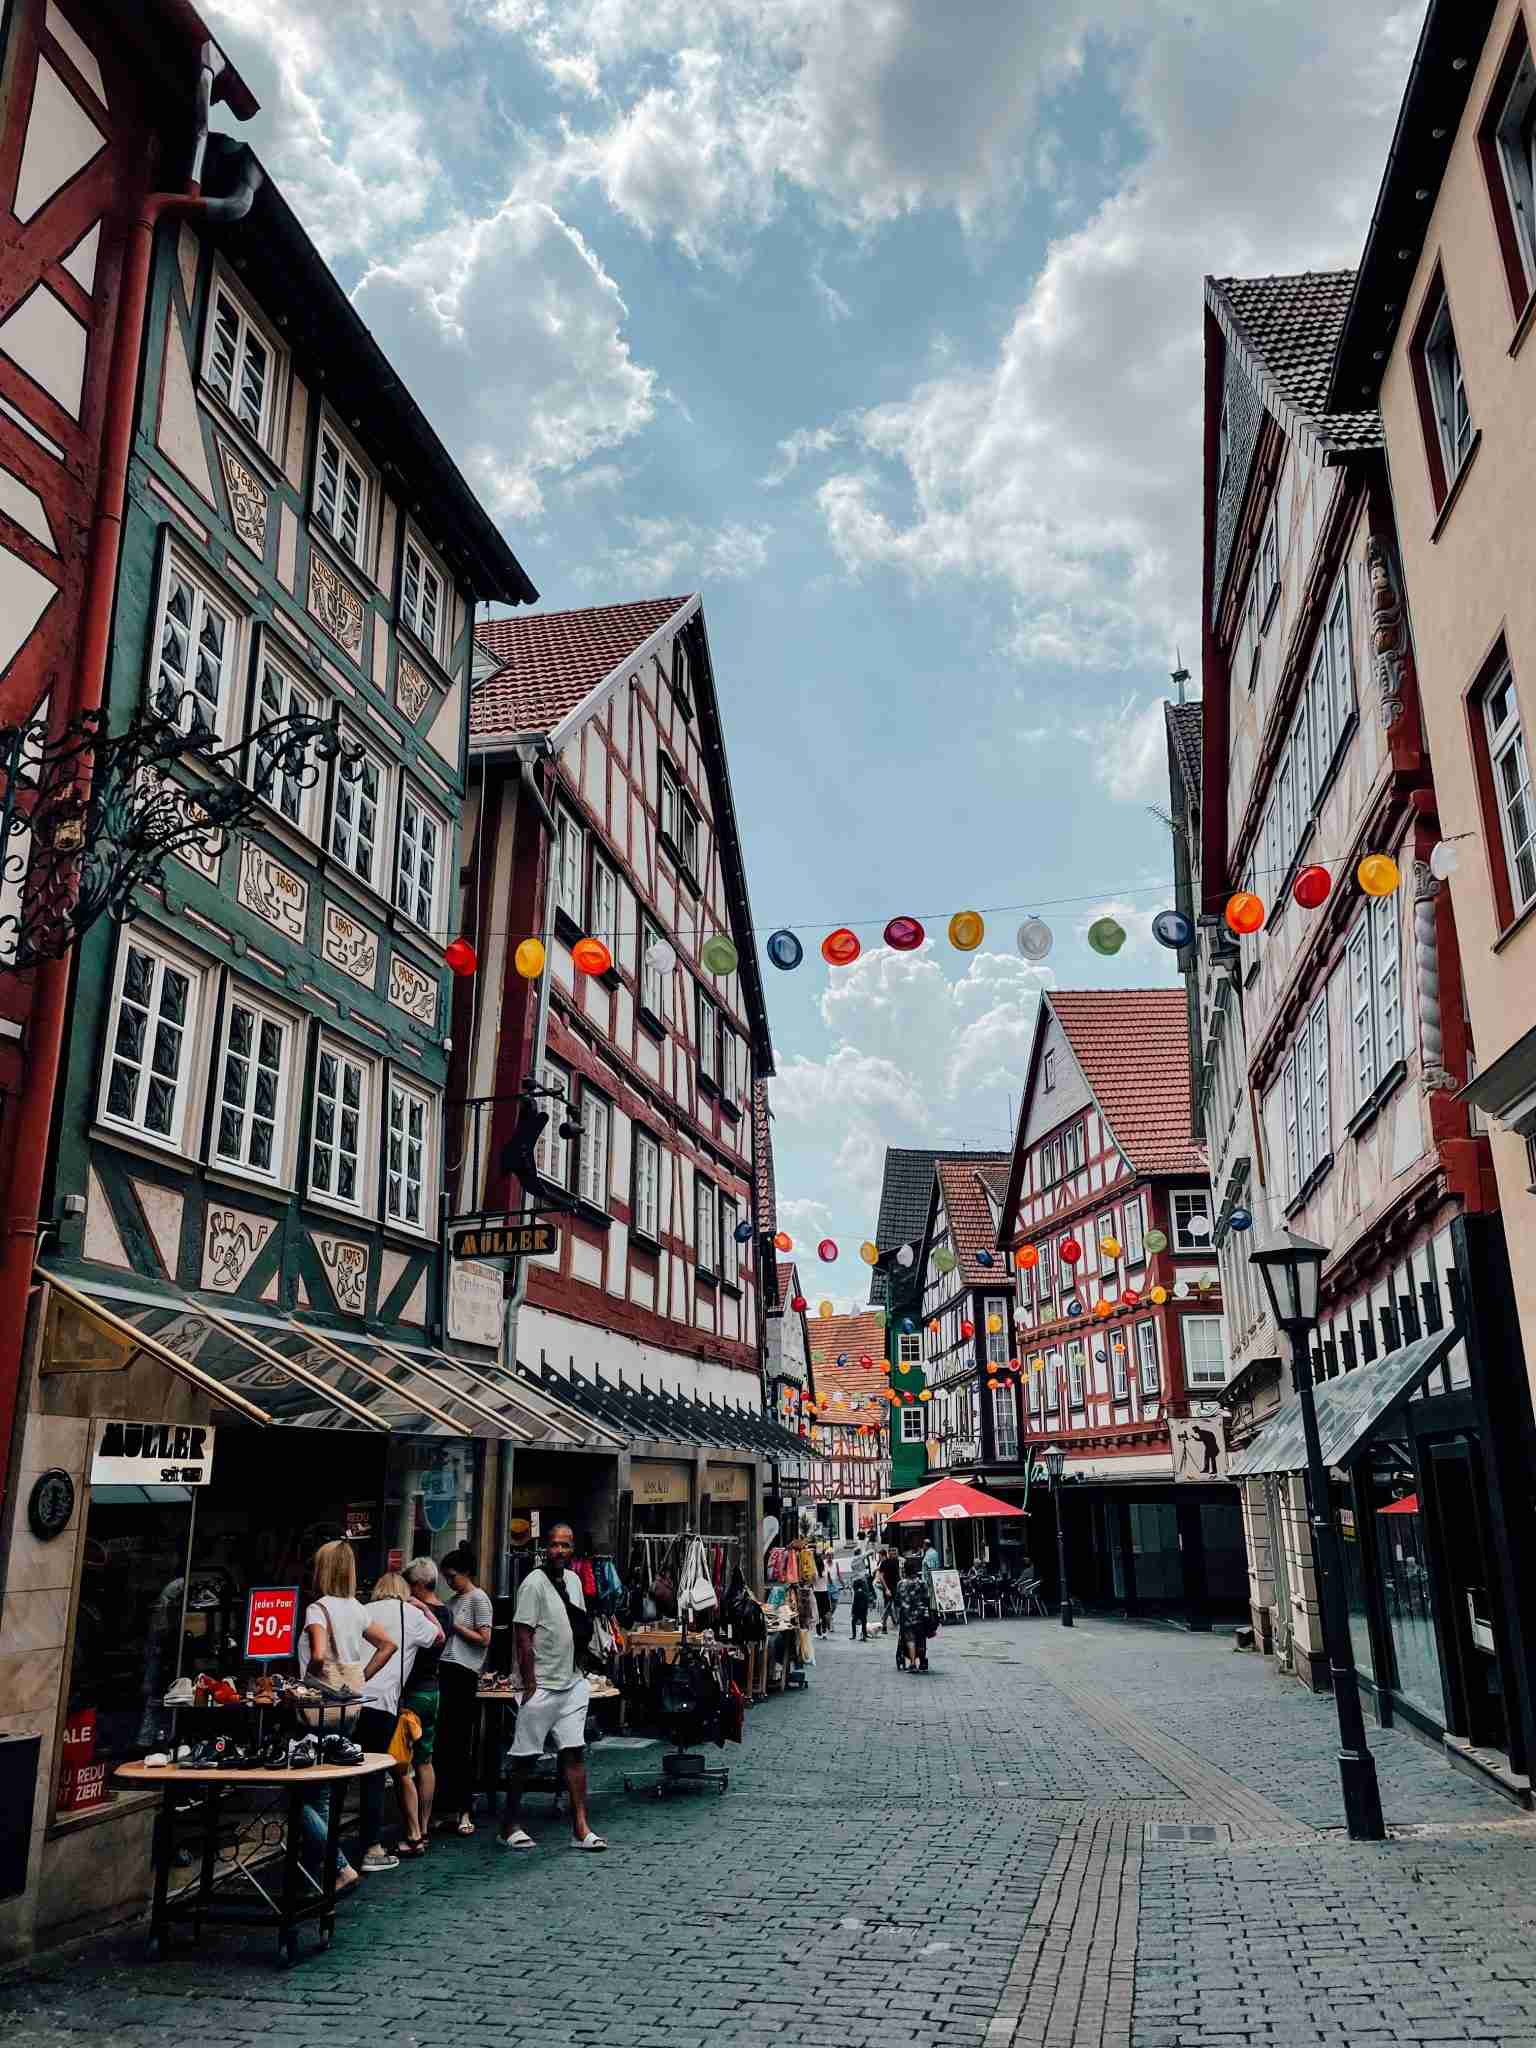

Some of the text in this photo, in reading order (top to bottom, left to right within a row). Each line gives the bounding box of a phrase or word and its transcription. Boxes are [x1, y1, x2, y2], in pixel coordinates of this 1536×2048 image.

[275, 870, 298, 898] 1860
[63, 1726, 92, 1744] ALE
[77, 1763, 105, 1784] REDU
[75, 1780, 104, 1802] ZIERT
